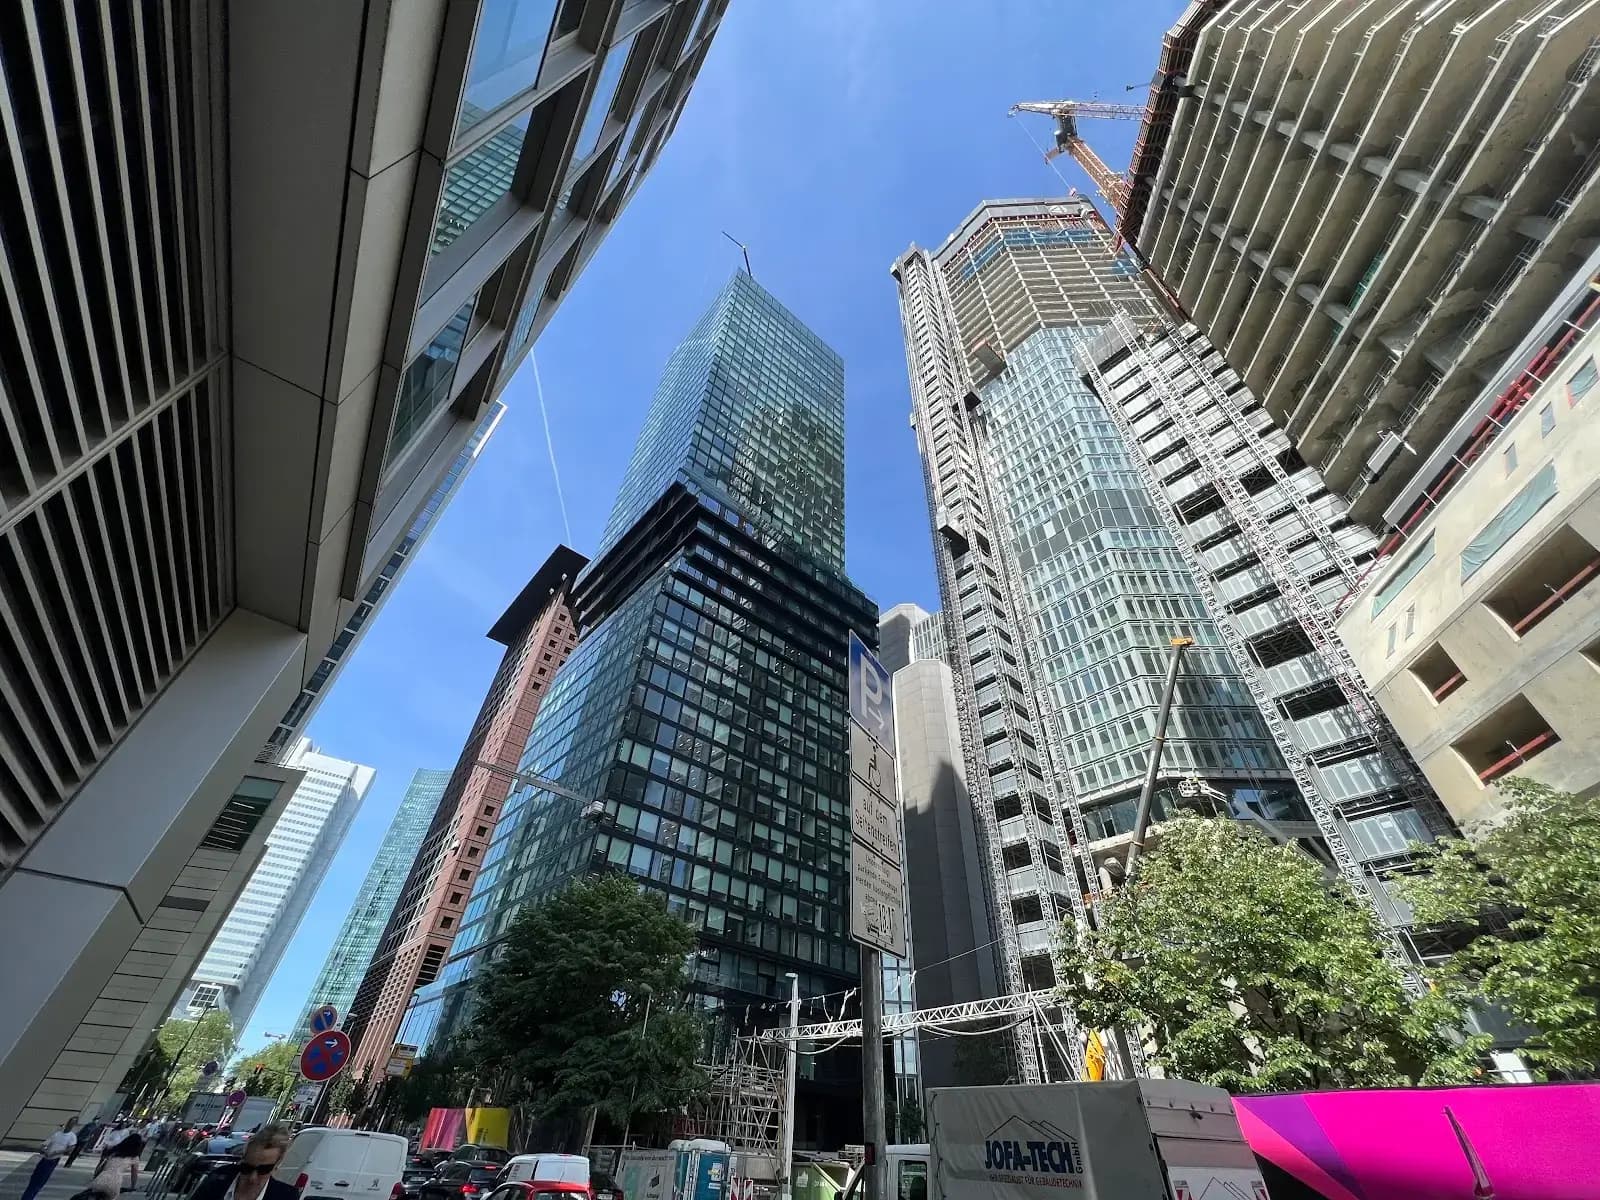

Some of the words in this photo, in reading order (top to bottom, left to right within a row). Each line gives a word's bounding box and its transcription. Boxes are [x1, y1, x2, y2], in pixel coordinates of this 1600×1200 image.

[861, 653, 882, 719] P
[863, 799, 873, 816] auf
[875, 808, 888, 825] dem
[855, 808, 897, 854] Seitenstreifen
[984, 1140, 1075, 1174] JOFA-TECH
[1071, 1142, 1084, 1174] GmbH
[1025, 1175, 1035, 1185] FÜR
